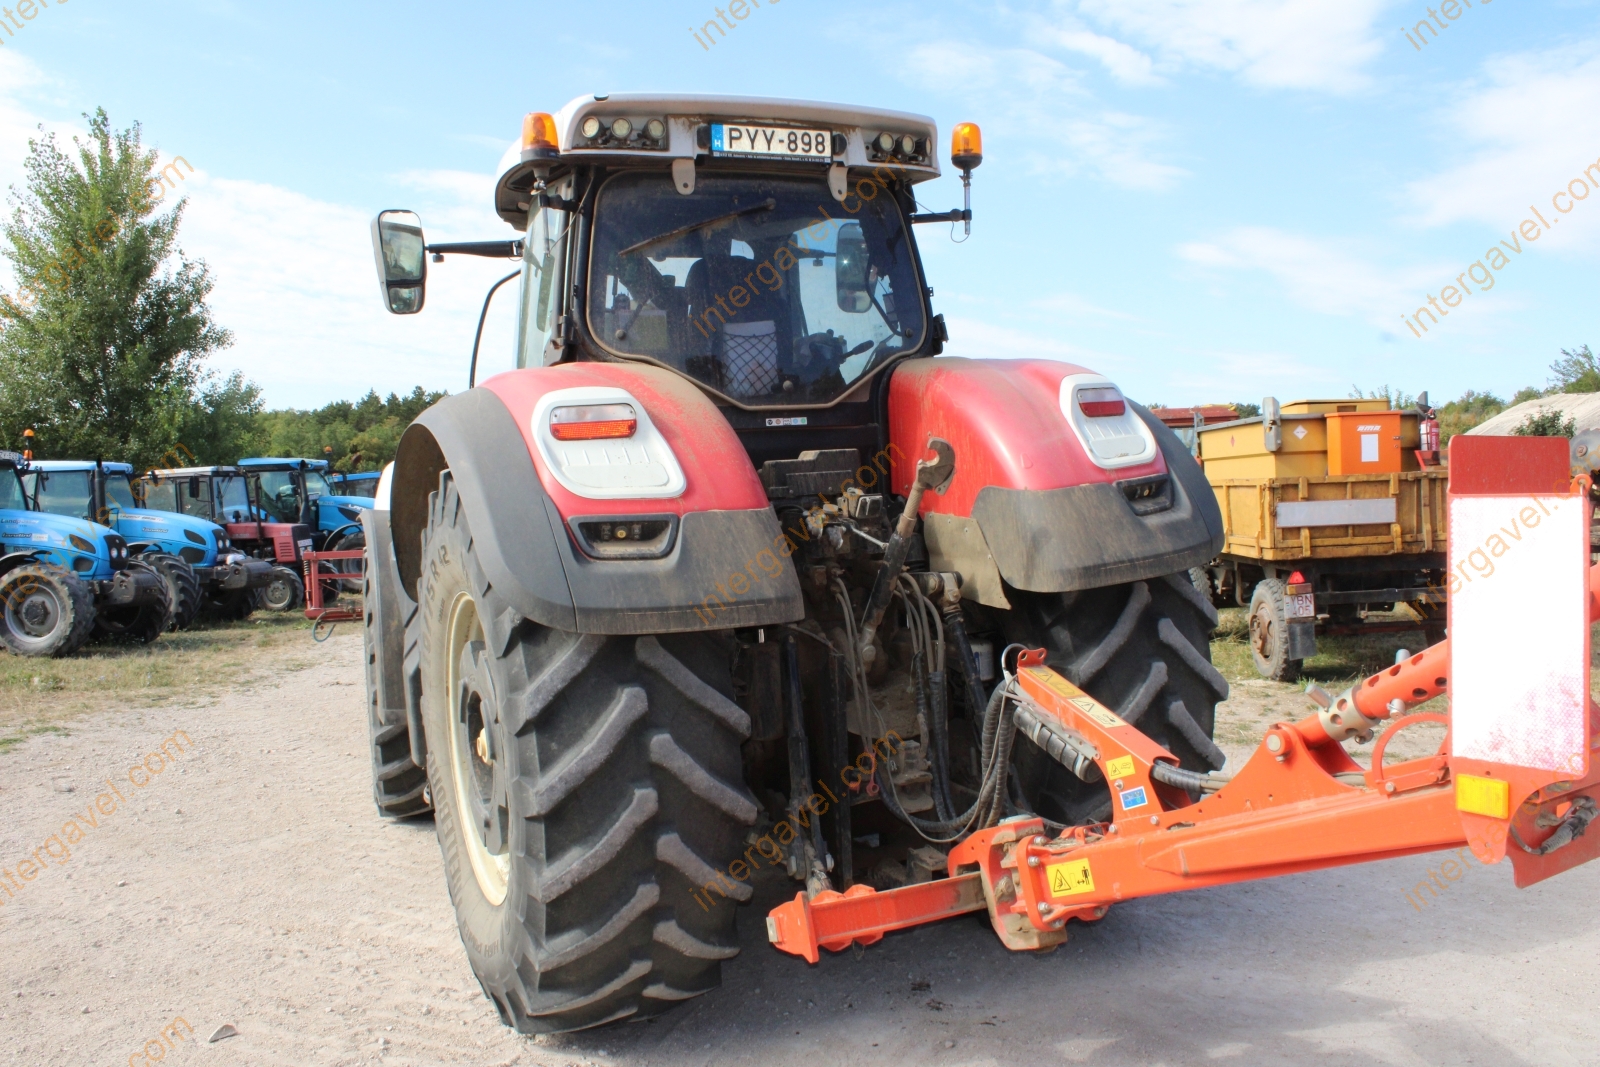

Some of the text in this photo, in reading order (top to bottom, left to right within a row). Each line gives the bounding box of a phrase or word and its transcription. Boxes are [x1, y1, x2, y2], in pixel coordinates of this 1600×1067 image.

[714, 139, 721, 148] H
[728, 127, 826, 154] PYY-898
[1291, 595, 1312, 606] YBN
[426, 749, 463, 909] TRELLEBORG
